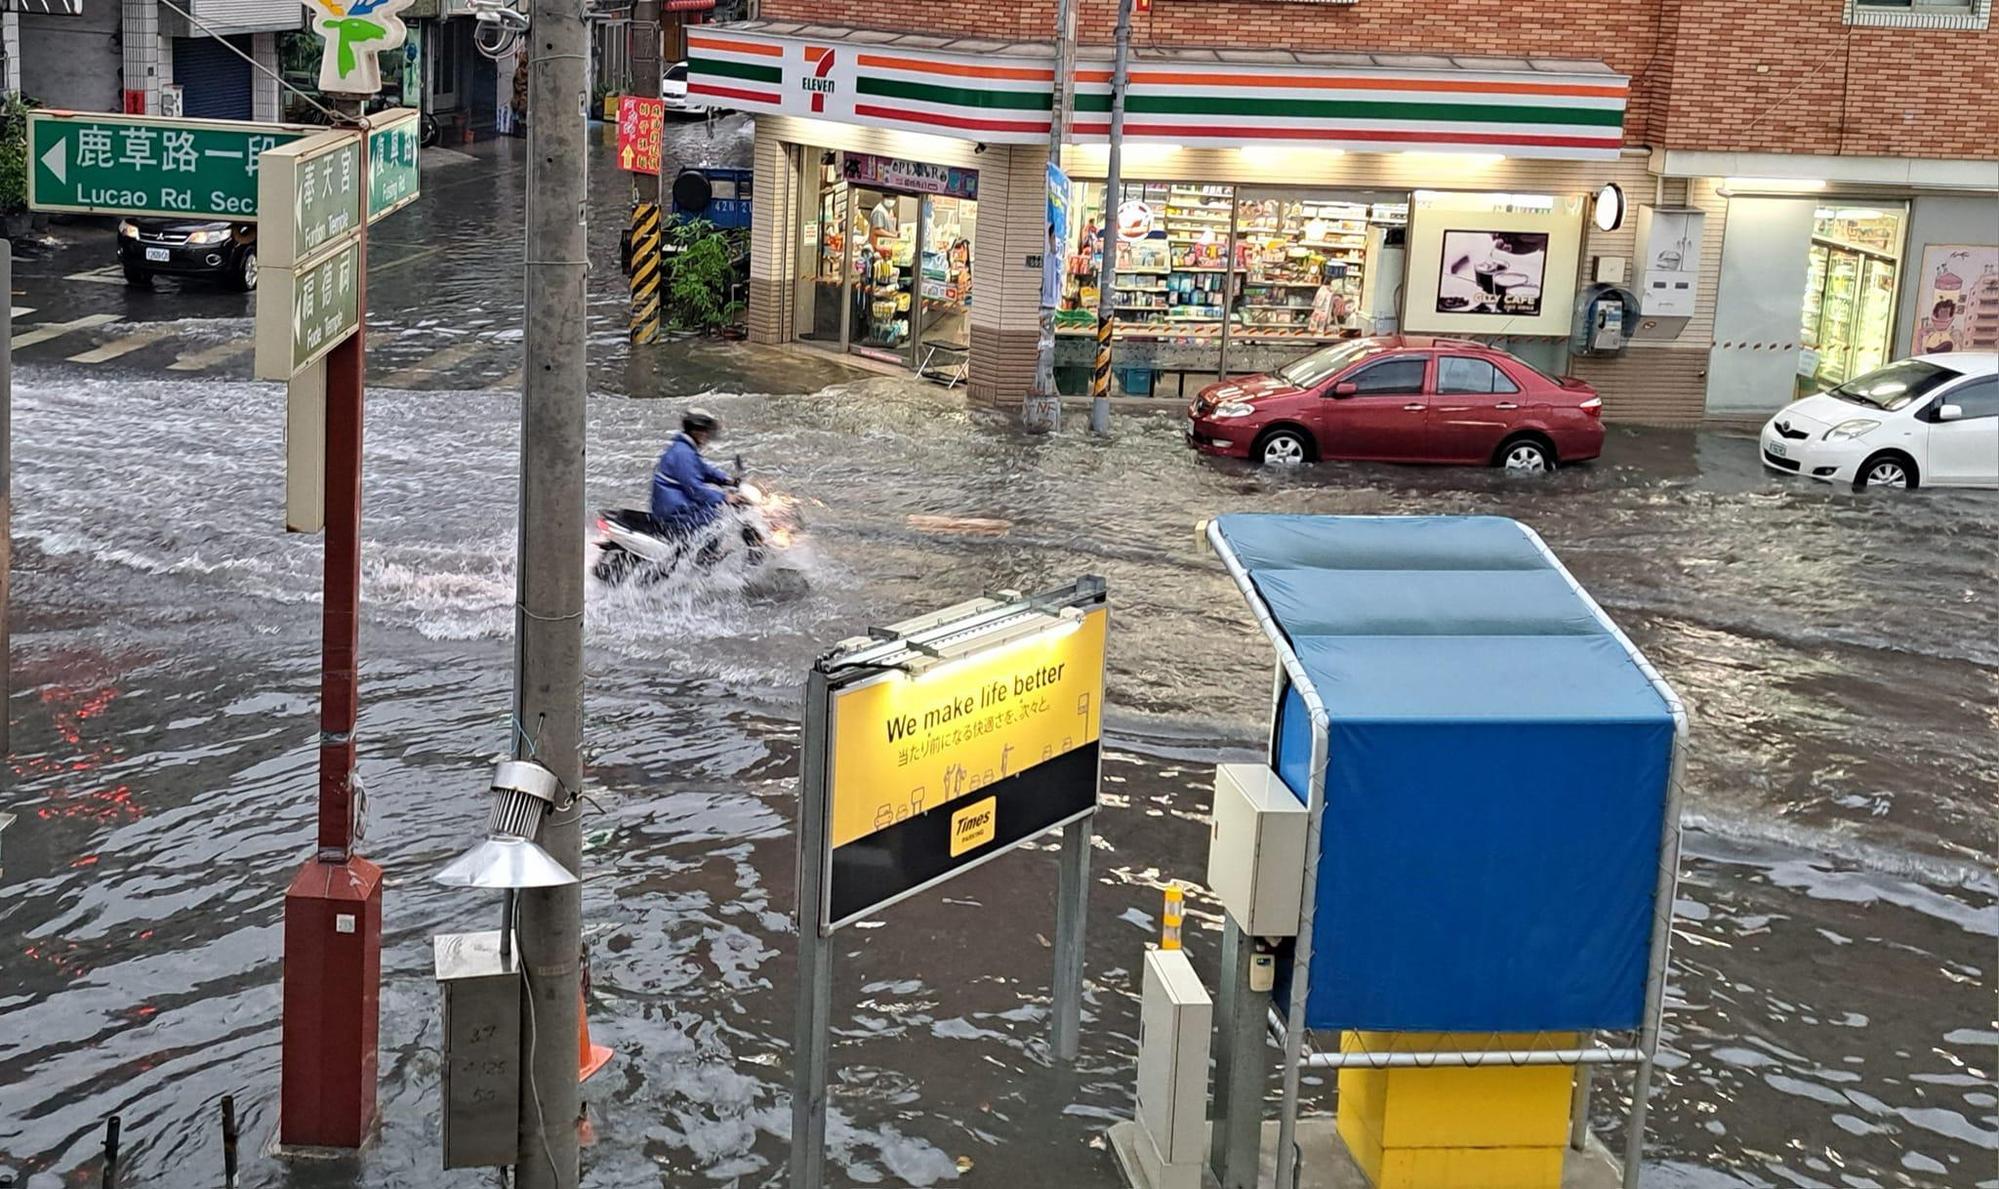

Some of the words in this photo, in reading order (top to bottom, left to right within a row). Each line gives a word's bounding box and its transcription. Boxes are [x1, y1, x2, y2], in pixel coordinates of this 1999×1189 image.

[77, 183, 147, 206] Lucao
[161, 188, 195, 209] Rd.
[328, 208, 350, 236] Temple
[1504, 295, 1535, 305] CAFE
[887, 714, 917, 743] We
[924, 696, 975, 730] make
[981, 680, 1008, 709] life
[1013, 663, 1066, 696] better
[956, 810, 991, 836] Times
